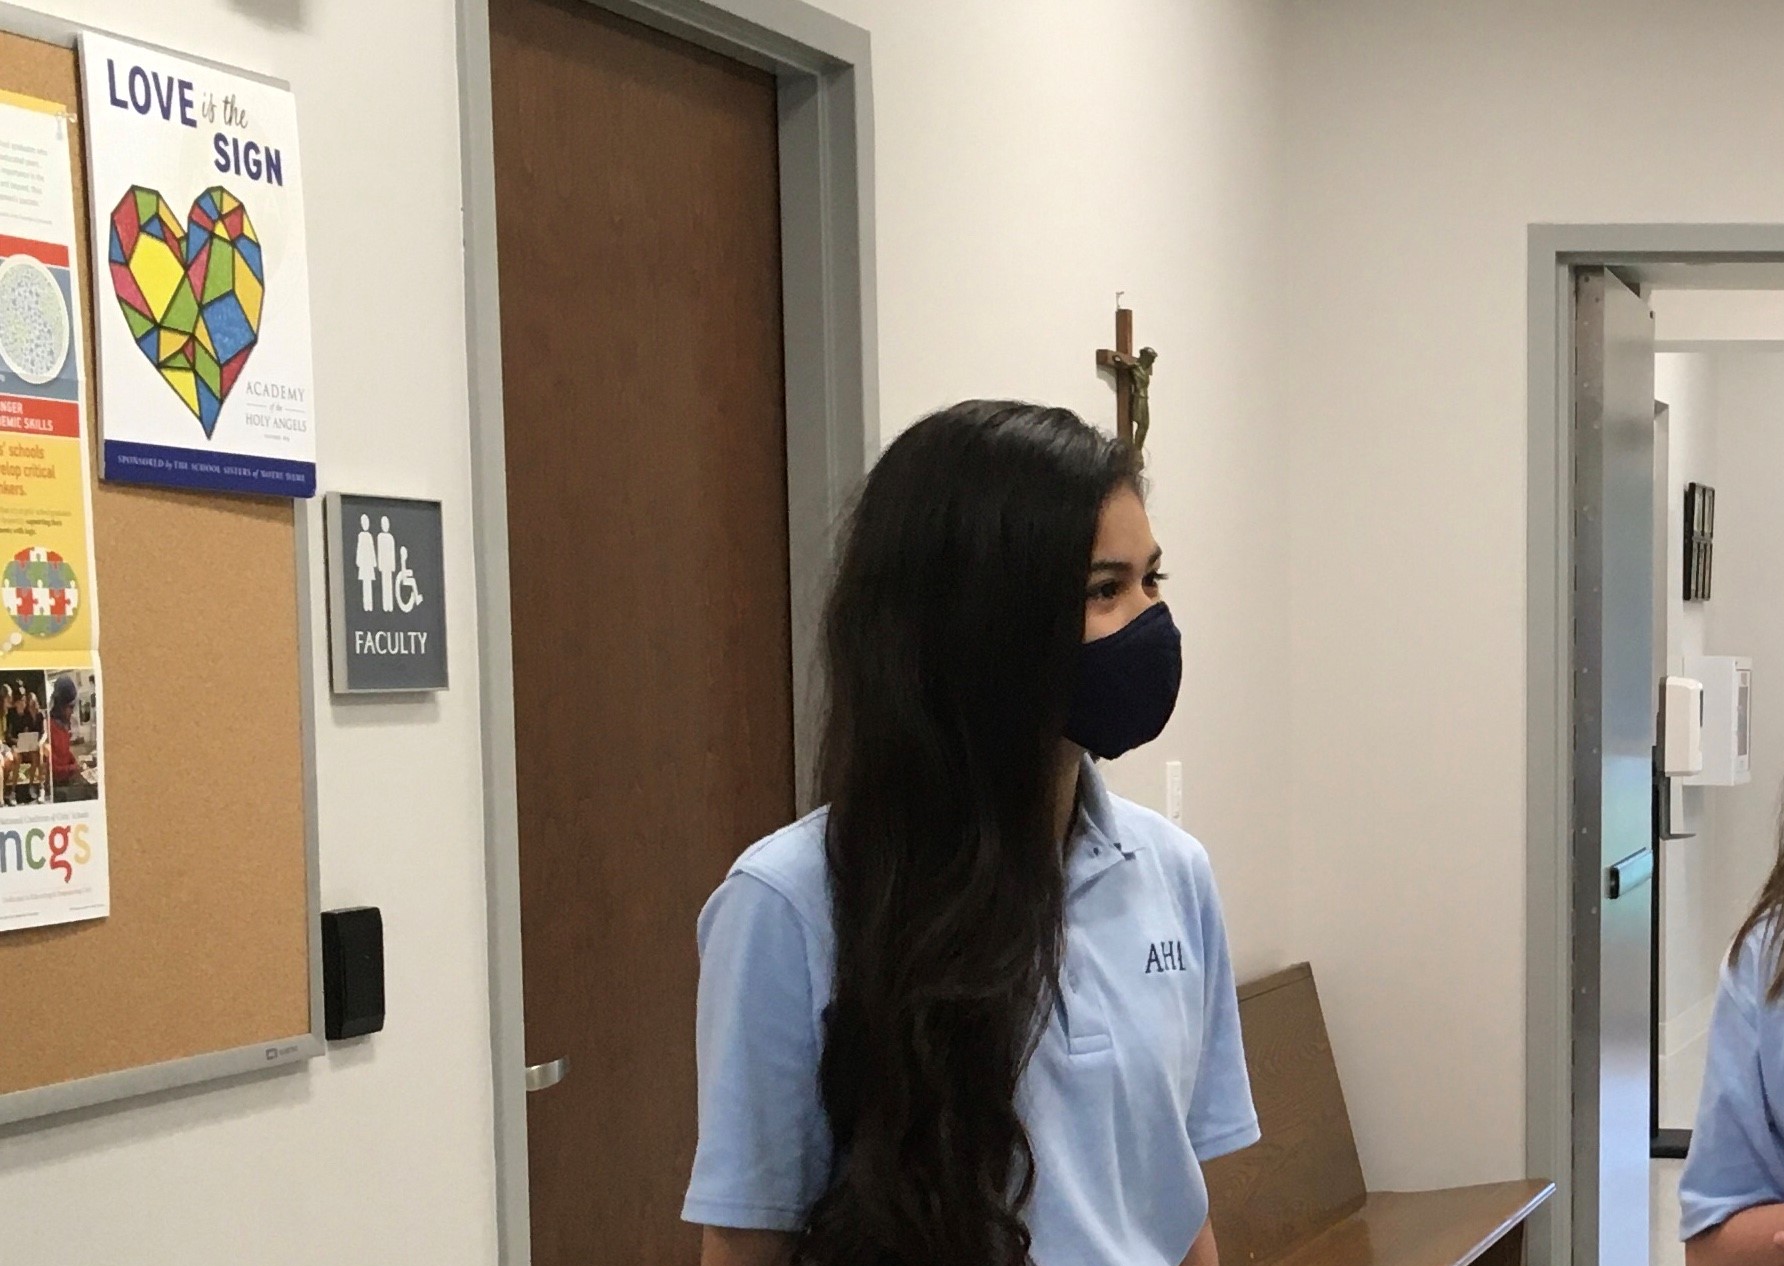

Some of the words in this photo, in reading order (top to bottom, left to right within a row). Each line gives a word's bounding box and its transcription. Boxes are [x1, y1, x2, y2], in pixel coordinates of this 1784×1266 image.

[107, 58, 197, 128] LOVE
[202, 92, 217, 123] is
[222, 94, 249, 129] the
[213, 132, 283, 186] SIGN
[246, 381, 304, 402] ACADEMY
[23, 417, 54, 432] SKILLS
[245, 412, 271, 427] HOLY
[273, 417, 307, 432] ANGELS
[9, 442, 45, 459] schools
[23, 463, 56, 479] critical
[191, 463, 220, 474] SCHOOL
[355, 631, 428, 654] FACULTY
[0, 823, 91, 884] ncgs
